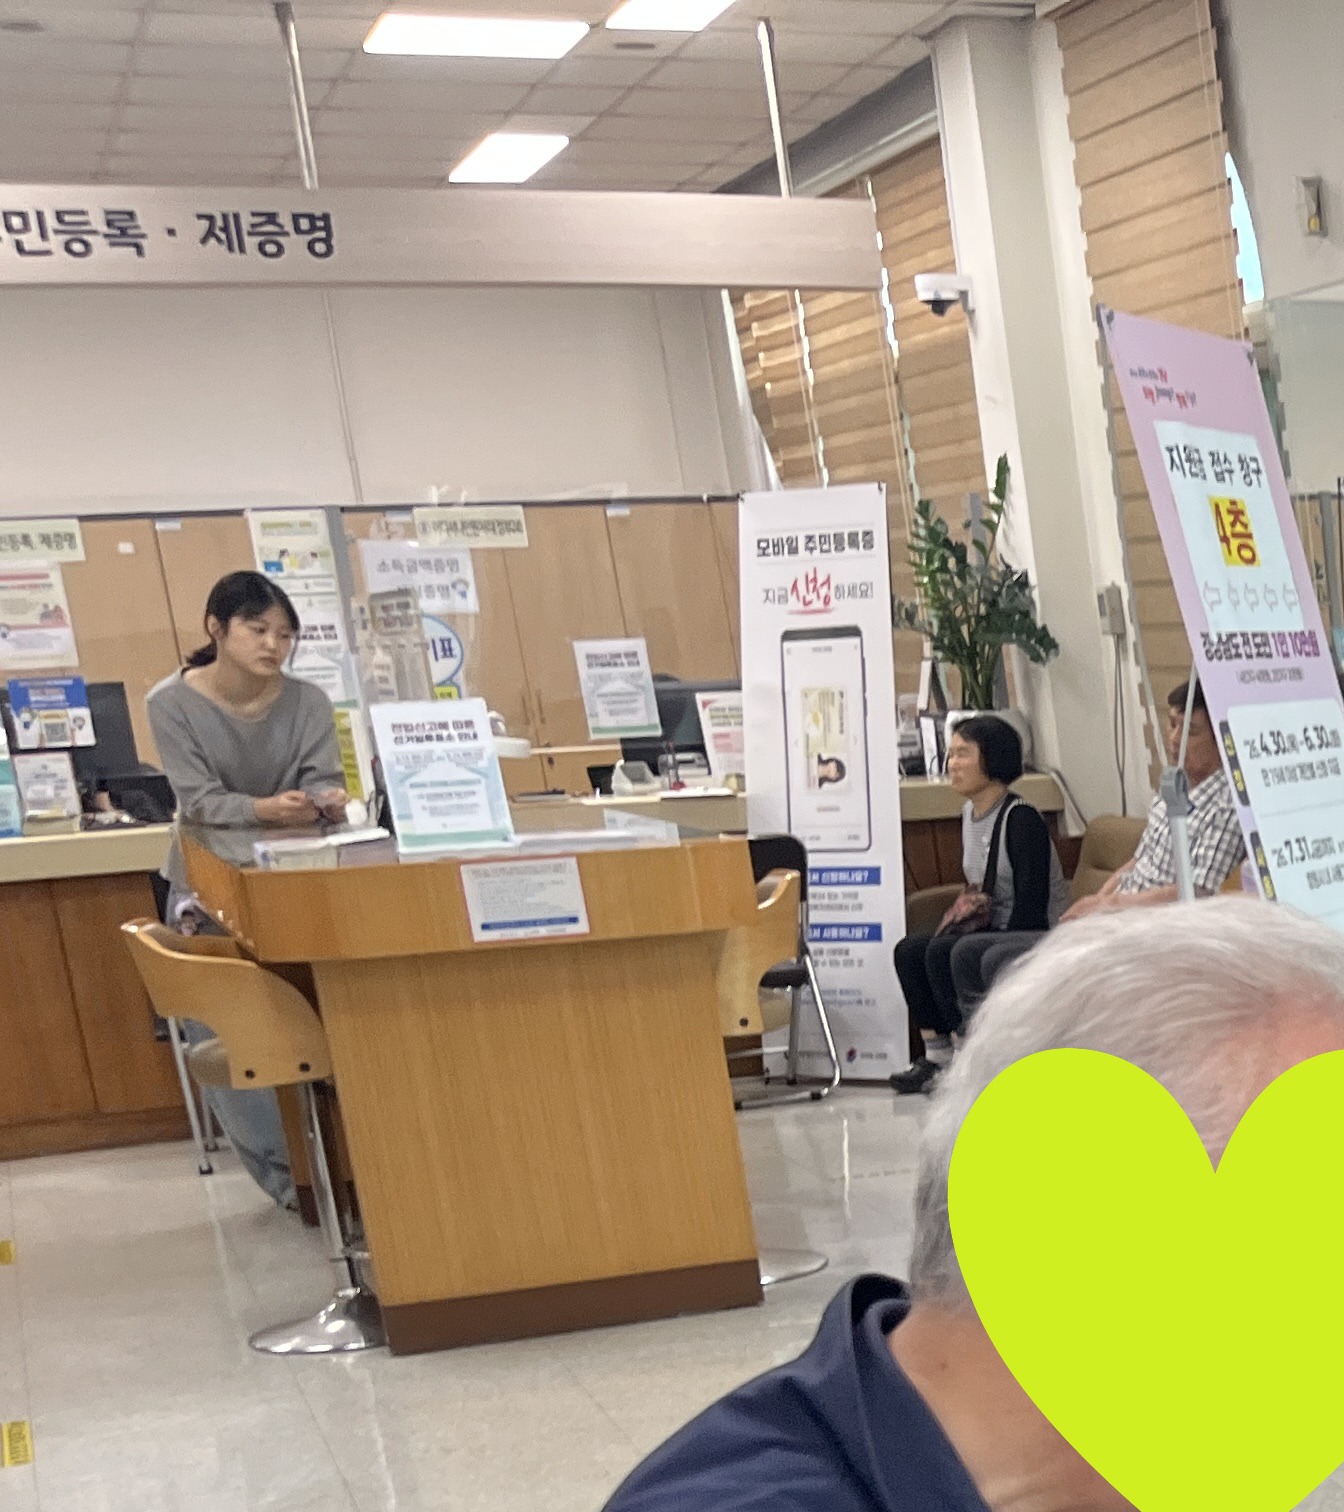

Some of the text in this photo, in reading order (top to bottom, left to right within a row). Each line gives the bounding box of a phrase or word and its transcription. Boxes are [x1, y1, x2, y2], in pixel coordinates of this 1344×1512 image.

[0, 209, 148, 258] 민등록
[195, 210, 335, 258] 제증명
[1208, 450, 1236, 484] 접수
[1237, 454, 1264, 489] 창구
[756, 530, 875, 558] 모바일 주민등록증
[1214, 500, 1259, 566] 4층
